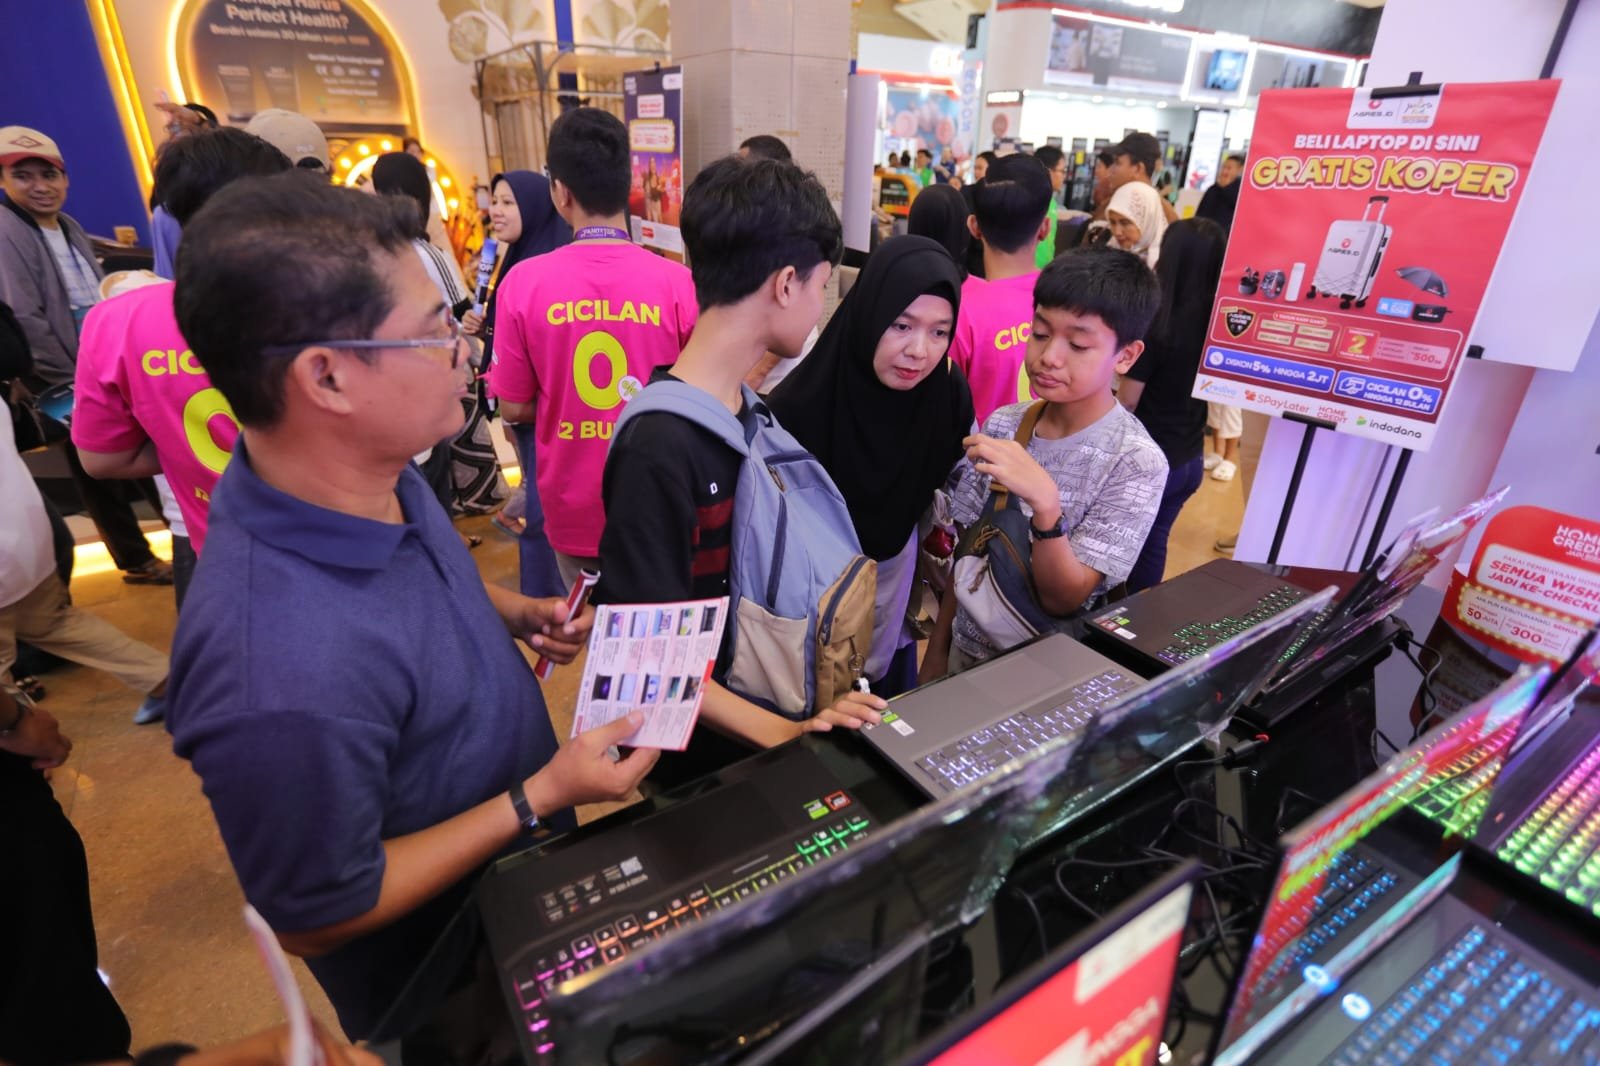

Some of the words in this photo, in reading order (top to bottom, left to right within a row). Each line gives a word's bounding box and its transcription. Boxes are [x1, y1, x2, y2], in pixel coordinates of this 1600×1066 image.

[225, 4, 287, 25] Perfect
[292, 11, 349, 29] Health?
[1294, 134, 1331, 149] BELI
[1332, 135, 1407, 150] LAPTOP
[1407, 136, 1431, 150] DI
[1435, 136, 1480, 151] SINI
[1252, 157, 1375, 188] GRATIS
[1379, 160, 1516, 199] KOPER
[546, 299, 660, 327] CICILAN
[994, 320, 1034, 351] CIC
[1348, 334, 1367, 354] 2
[1225, 358, 1253, 369] DISKON
[1273, 367, 1305, 379] HINGGA
[1363, 391, 1393, 403] HINGGA
[1403, 399, 1431, 411] BULAN
[1366, 382, 1406, 398] CICILAN
[1407, 387, 1433, 403] 0%
[1257, 394, 1310, 413] SPayLater
[1318, 406, 1348, 417] HOME
[1316, 412, 1349, 424] CREDIT
[580, 420, 616, 440] BU
[1369, 419, 1422, 438] indodana
[1556, 525, 1600, 548] HOM
[1488, 572, 1518, 586] JADI
[1490, 560, 1546, 584] SEMUA
[1552, 579, 1600, 602] WISH
[1466, 607, 1482, 620] 50
[1510, 626, 1542, 643] 300
